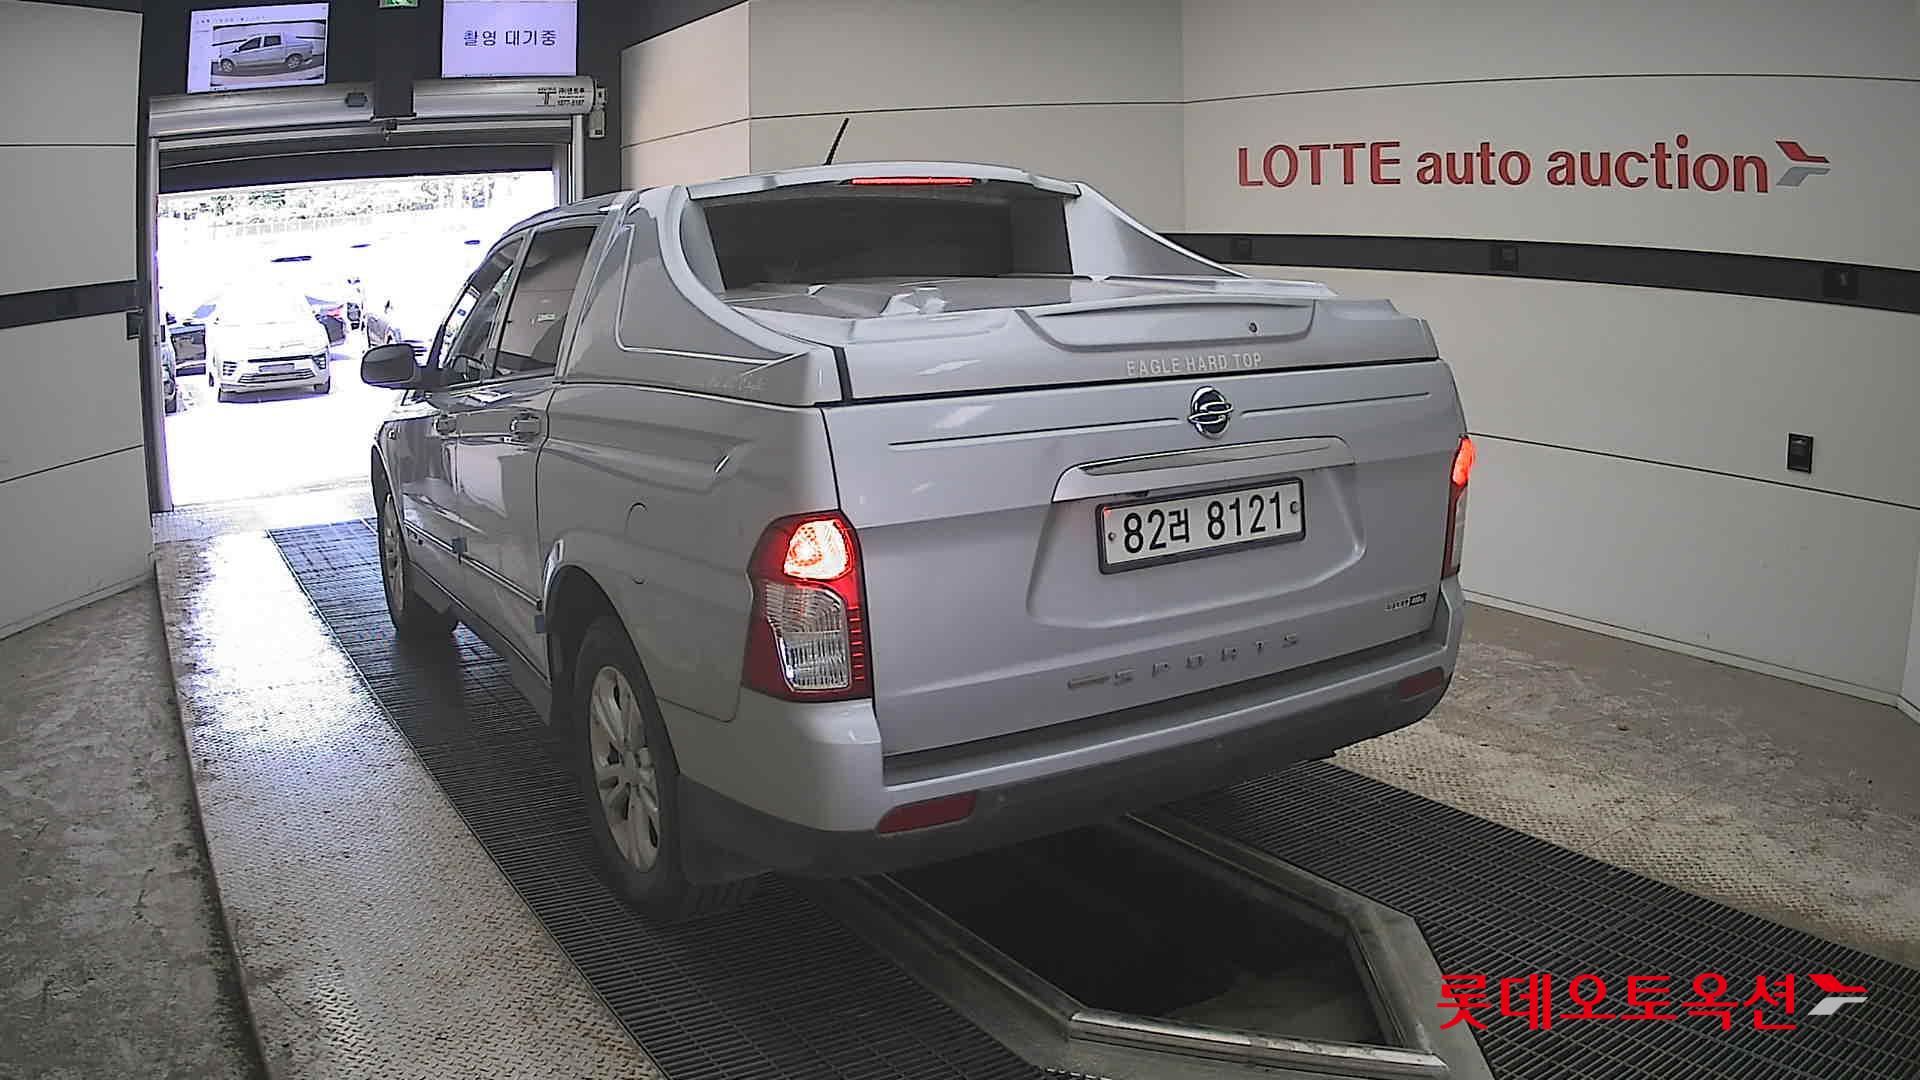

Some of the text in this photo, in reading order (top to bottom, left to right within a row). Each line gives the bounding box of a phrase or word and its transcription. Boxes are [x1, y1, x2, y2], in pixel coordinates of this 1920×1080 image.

[463, 30, 557, 47] 촬영 대기중
[1237, 135, 1769, 193] LOTTE auto auction
[1126, 352, 1263, 377] EAGLE HARD TOP
[1123, 490, 1282, 554] 82러 8121
